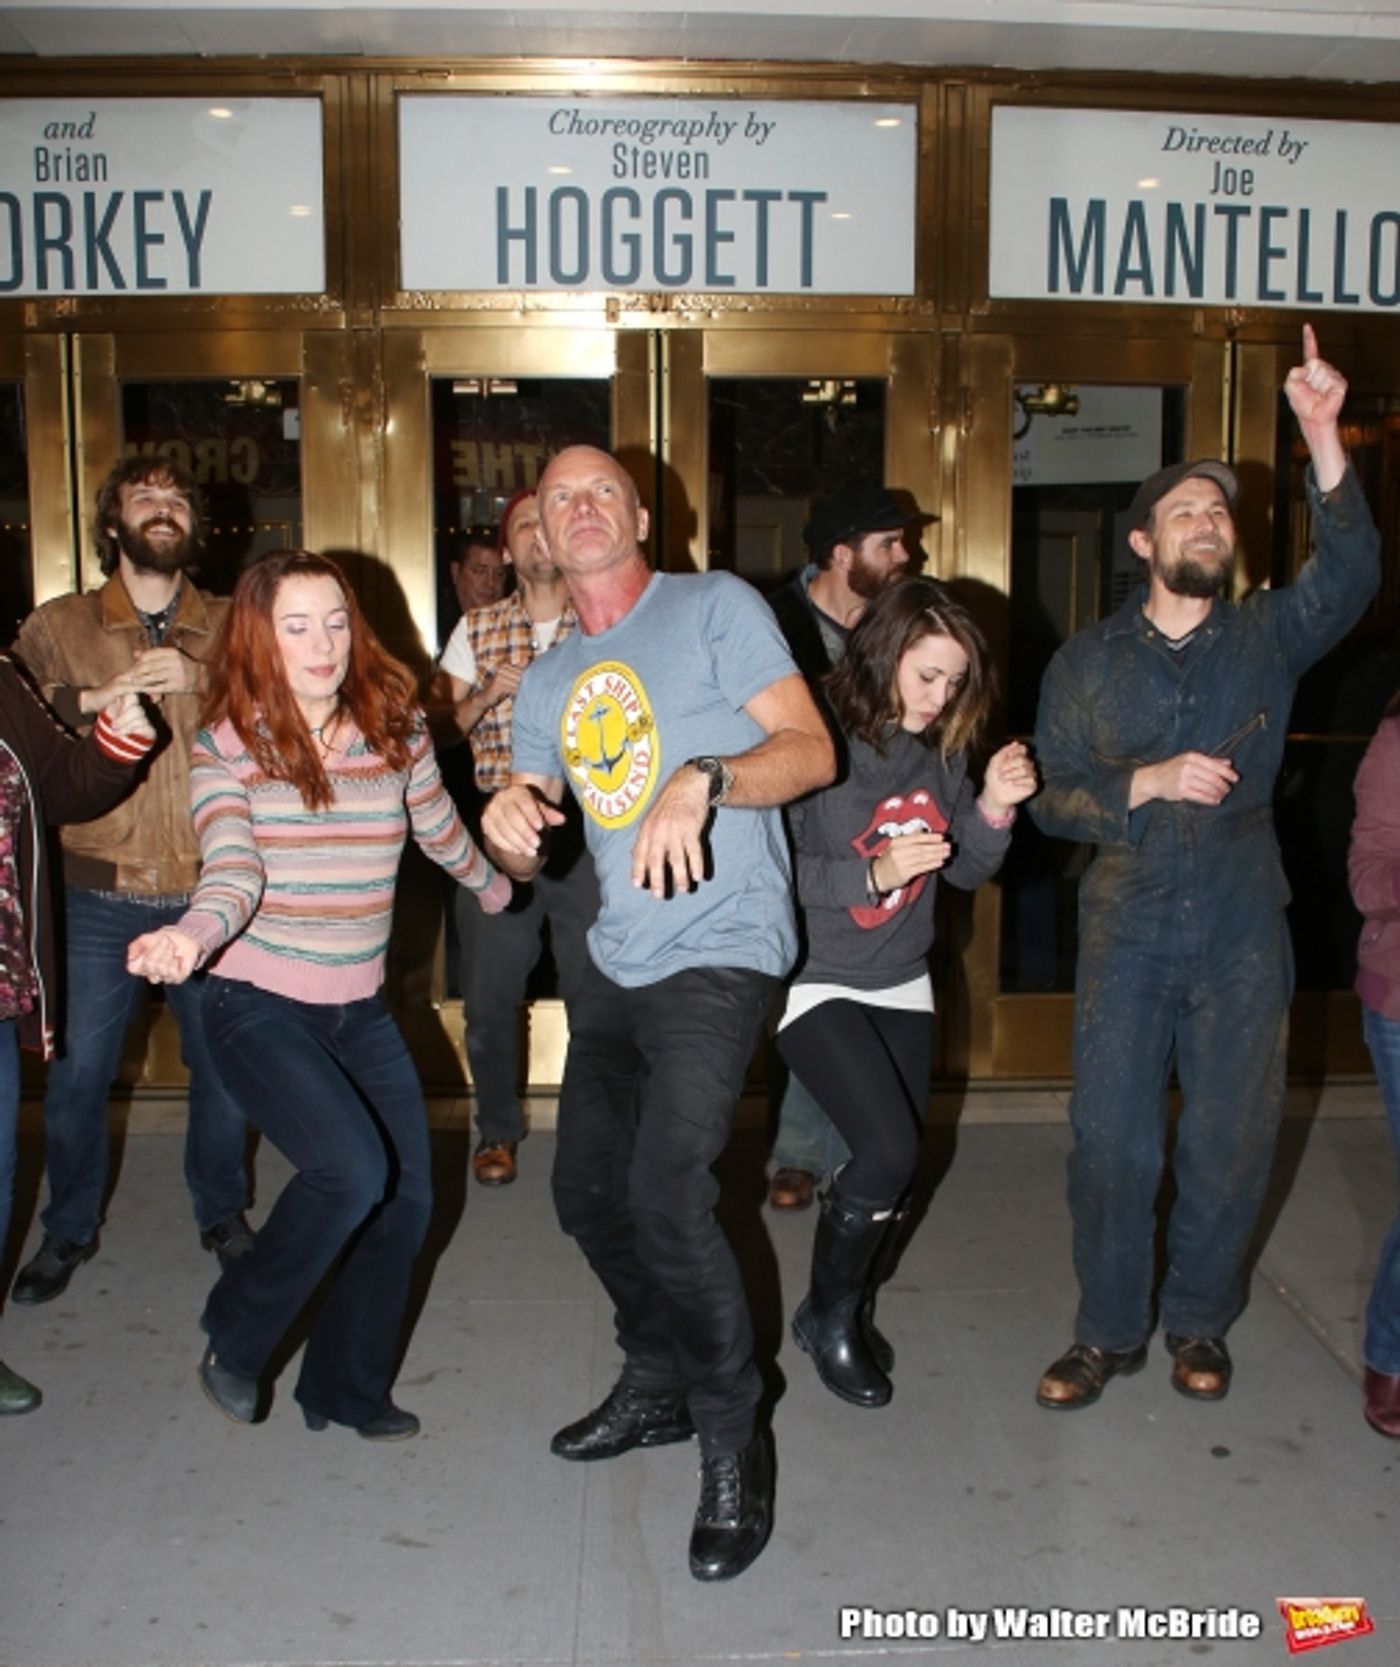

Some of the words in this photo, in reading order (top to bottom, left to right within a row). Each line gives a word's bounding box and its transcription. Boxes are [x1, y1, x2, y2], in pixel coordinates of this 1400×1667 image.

[43, 111, 96, 139] and
[548, 108, 737, 145] Choreography
[744, 111, 777, 145] by
[34, 146, 107, 182] Brian
[612, 141, 710, 180] Steven
[1161, 126, 1273, 157] Directed
[1277, 130, 1309, 164] by
[1210, 160, 1255, 196] Joe
[496, 185, 829, 288] HOGGETT
[1046, 196, 1400, 306] MANTELLO
[567, 681, 594, 737] LAST
[604, 675, 640, 712] SHIP
